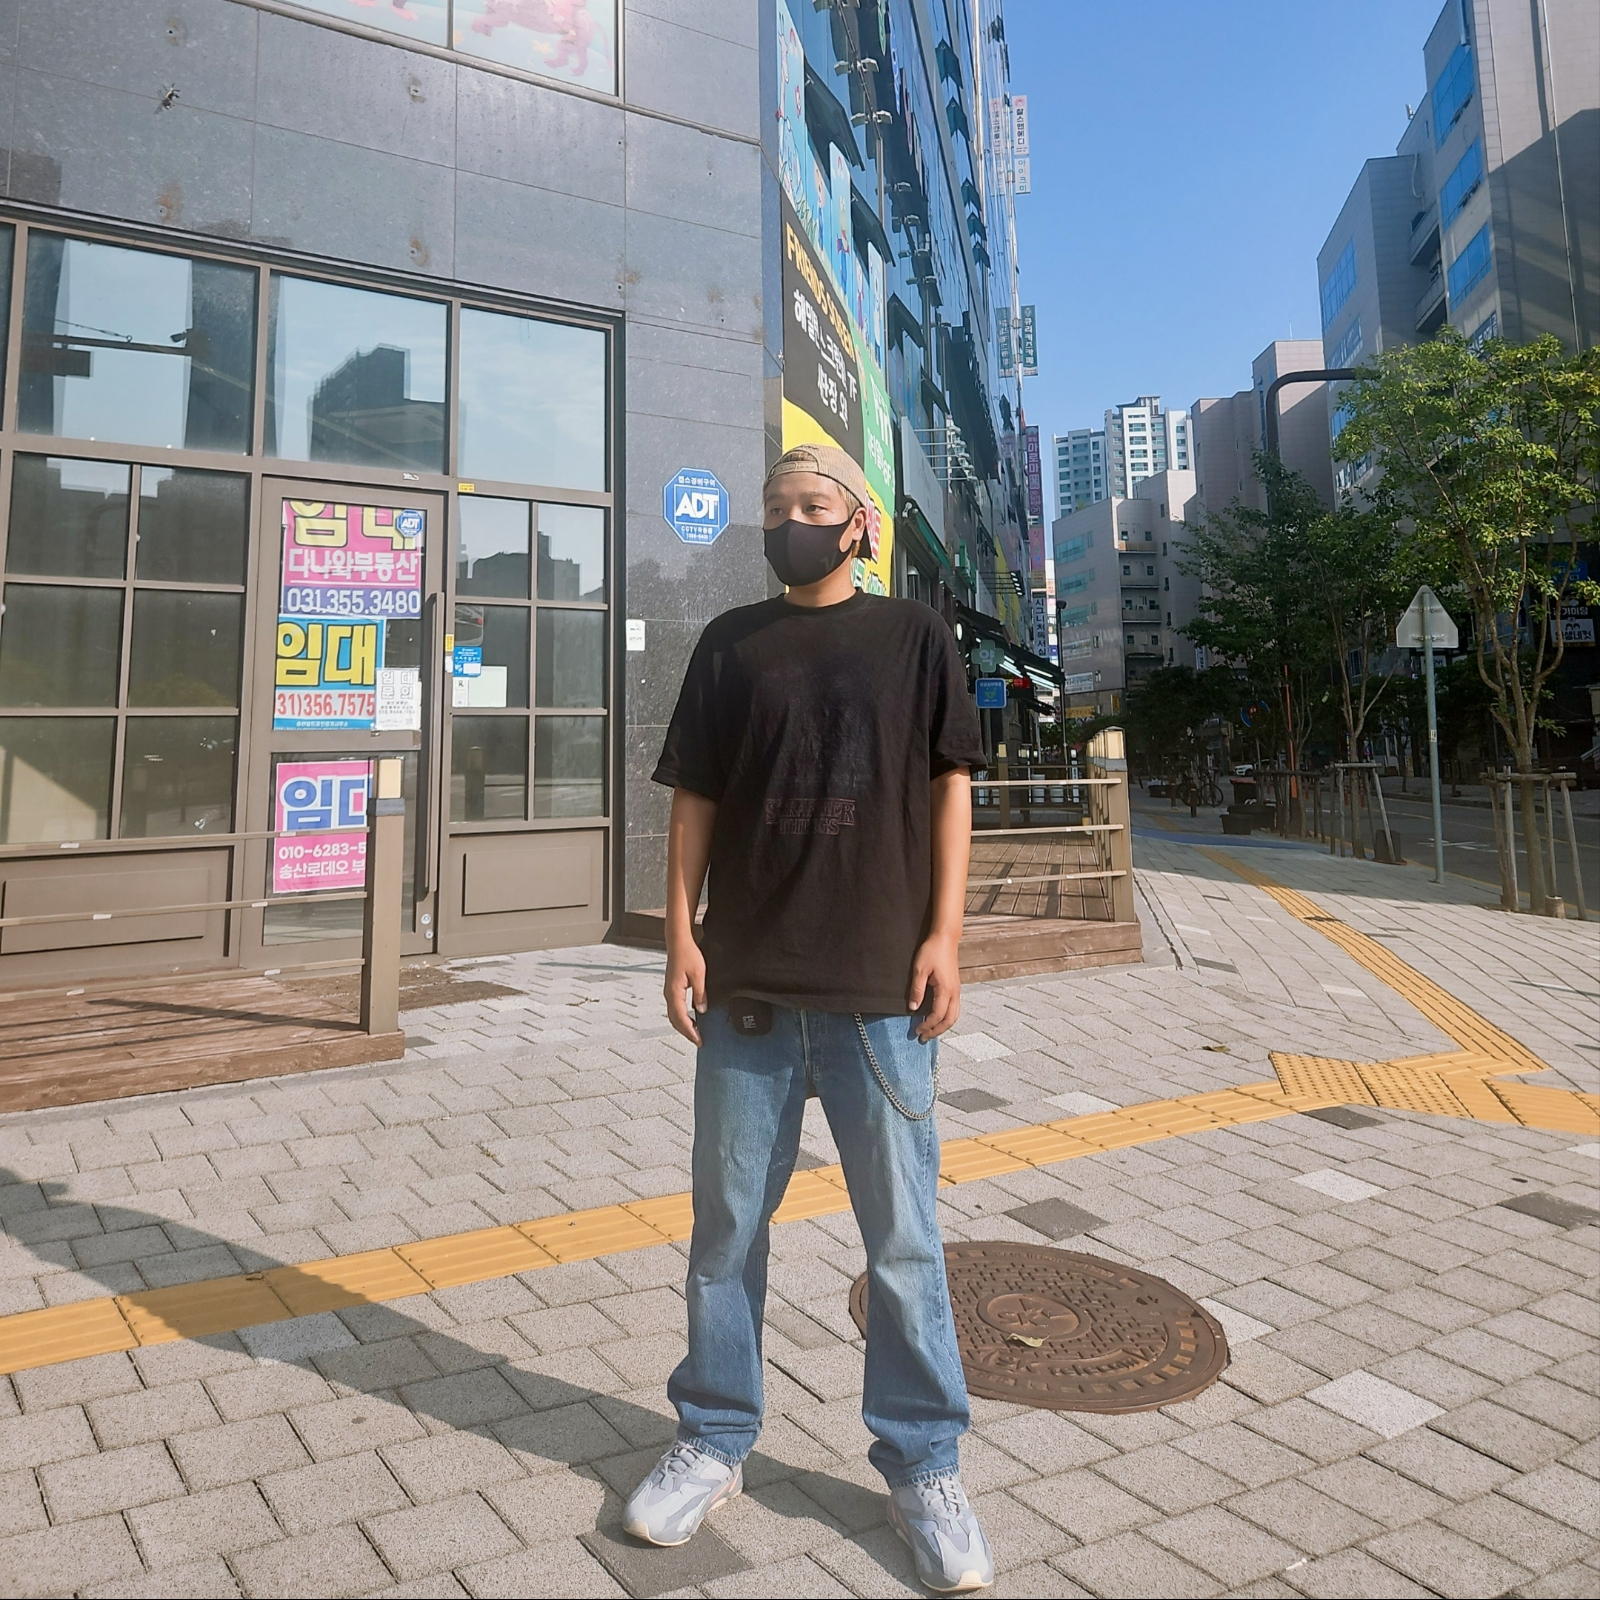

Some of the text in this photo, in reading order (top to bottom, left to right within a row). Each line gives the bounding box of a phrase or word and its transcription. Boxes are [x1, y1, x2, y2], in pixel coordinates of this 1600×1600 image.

[786, 221, 829, 315] FRIENDS
[1028, 442, 1039, 473] 아로마
[675, 492, 719, 520] ADT
[401, 518, 420, 529] ADT
[289, 548, 418, 582] 다나와부동산
[287, 587, 421, 615] 031.355.3480
[1035, 598, 1047, 657] 시그니처독서실
[275, 622, 377, 686] 임대
[979, 649, 996, 667] 약
[279, 859, 349, 879] 송산로데오
